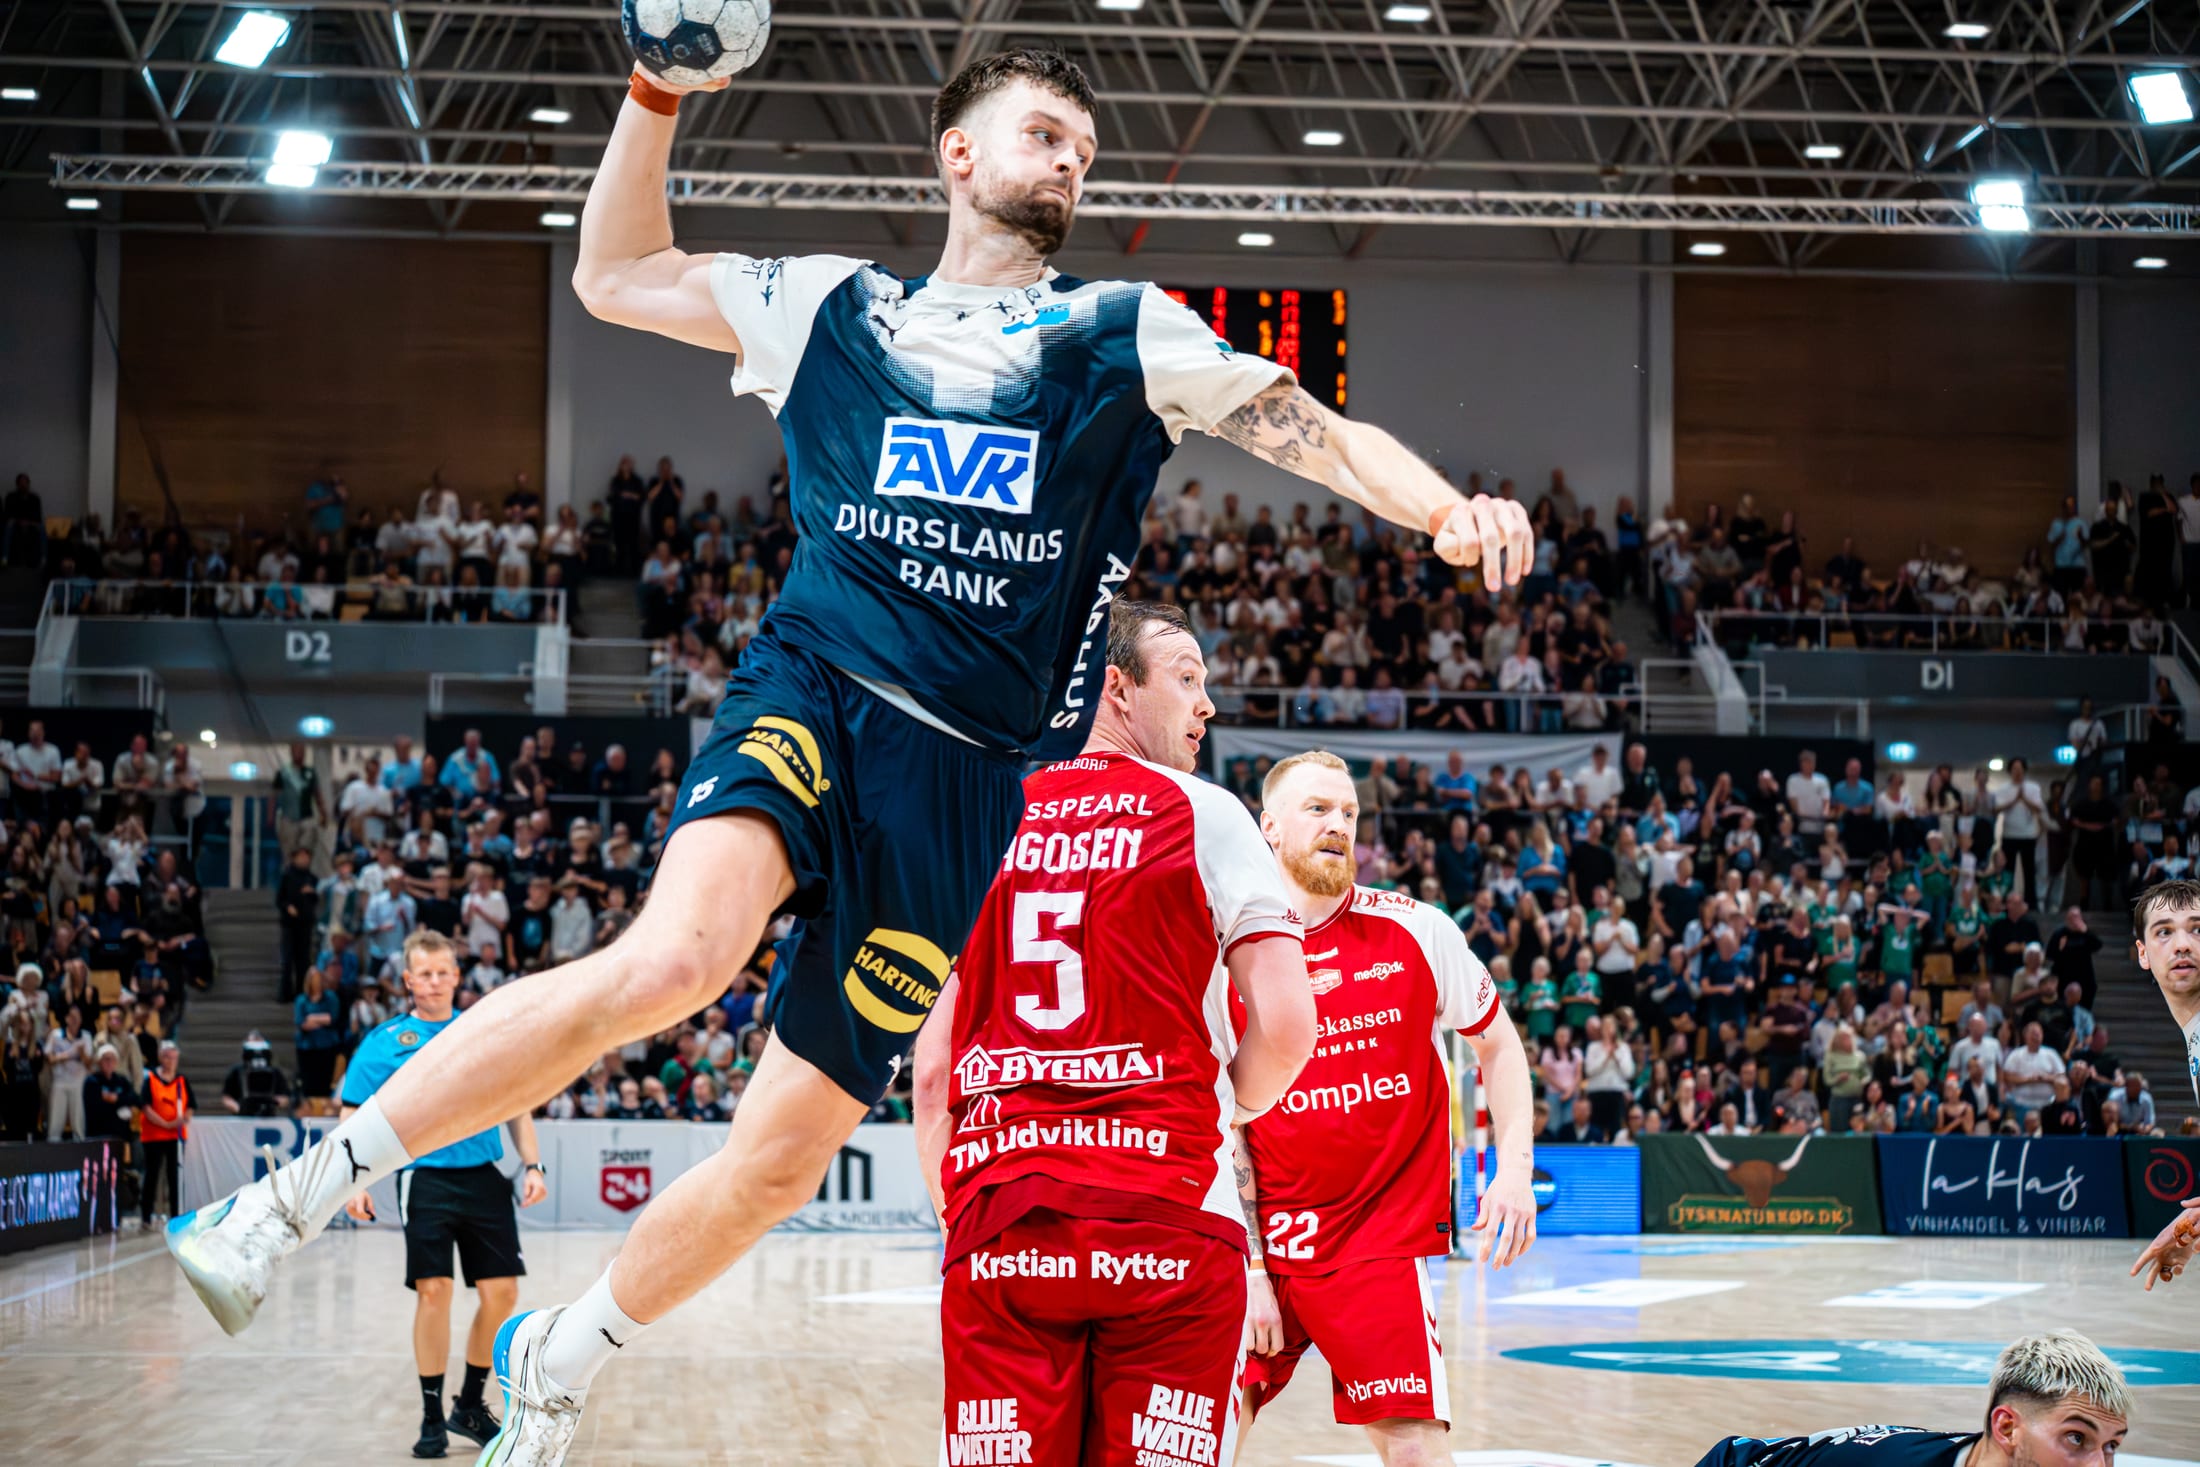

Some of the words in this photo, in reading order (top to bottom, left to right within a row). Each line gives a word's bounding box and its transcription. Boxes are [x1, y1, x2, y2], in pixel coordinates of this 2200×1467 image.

[834, 503, 1064, 563] DJURSLANDS
[899, 558, 1012, 608] BANK
[286, 630, 332, 660] D2
[745, 729, 811, 782] HART
[1045, 757, 1109, 773] AALBORG
[1024, 793, 1153, 821] SSPEARL
[853, 944, 939, 1009] HARTING
[1012, 890, 1086, 1031] 5
[1316, 1006, 1402, 1039] ekassen
[1000, 1050, 1155, 1082] BYGMA
[1310, 1036, 1379, 1059] NMARK
[949, 1135, 991, 1173] TN
[995, 1117, 1169, 1157] Udvikling
[605, 1171, 649, 1201] 24
[1265, 1211, 1319, 1260] 22
[1905, 1214, 2010, 1234] VINHANDEL
[2017, 1215, 2030, 1234] &
[2036, 1215, 2107, 1234] VINBAR
[1091, 1250, 1191, 1285] Rytter
[1354, 1372, 1428, 1402] bravida
[957, 1397, 1019, 1434] BLUE
[1146, 1383, 1216, 1431] BLUE
[949, 1430, 1034, 1467] WATER
[1131, 1411, 1218, 1467] WATER
